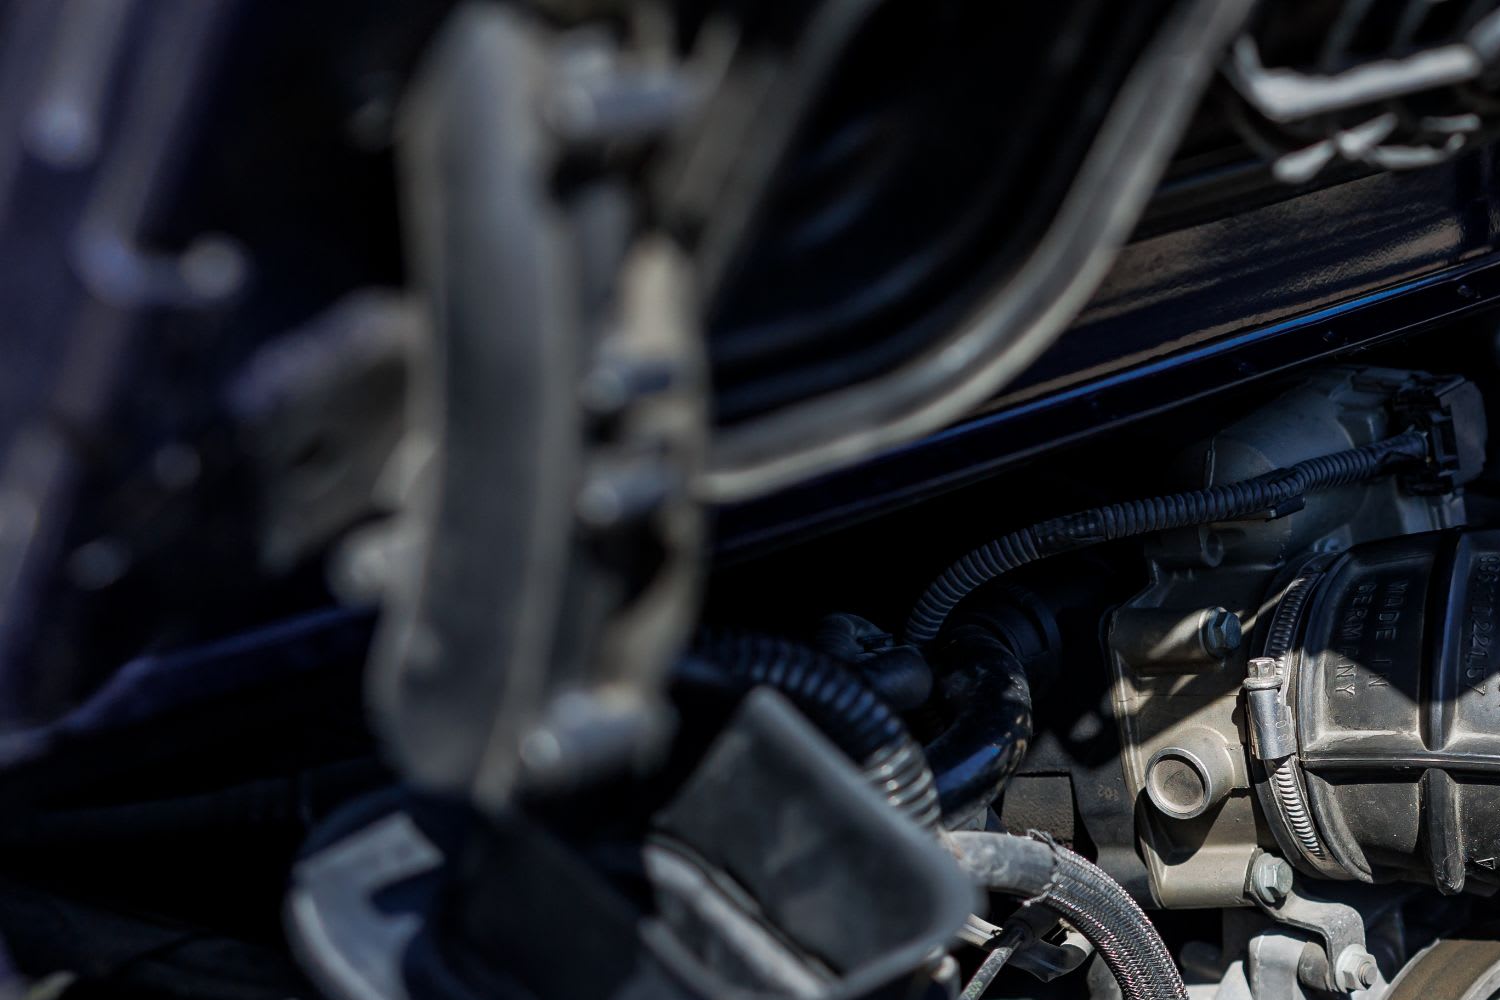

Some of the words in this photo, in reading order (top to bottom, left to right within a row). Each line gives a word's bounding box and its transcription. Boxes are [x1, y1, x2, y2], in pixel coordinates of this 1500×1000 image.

[1335, 582, 1379, 697] GERMANY
[1375, 579, 1410, 641] MADE
[1367, 658, 1394, 691] IN
